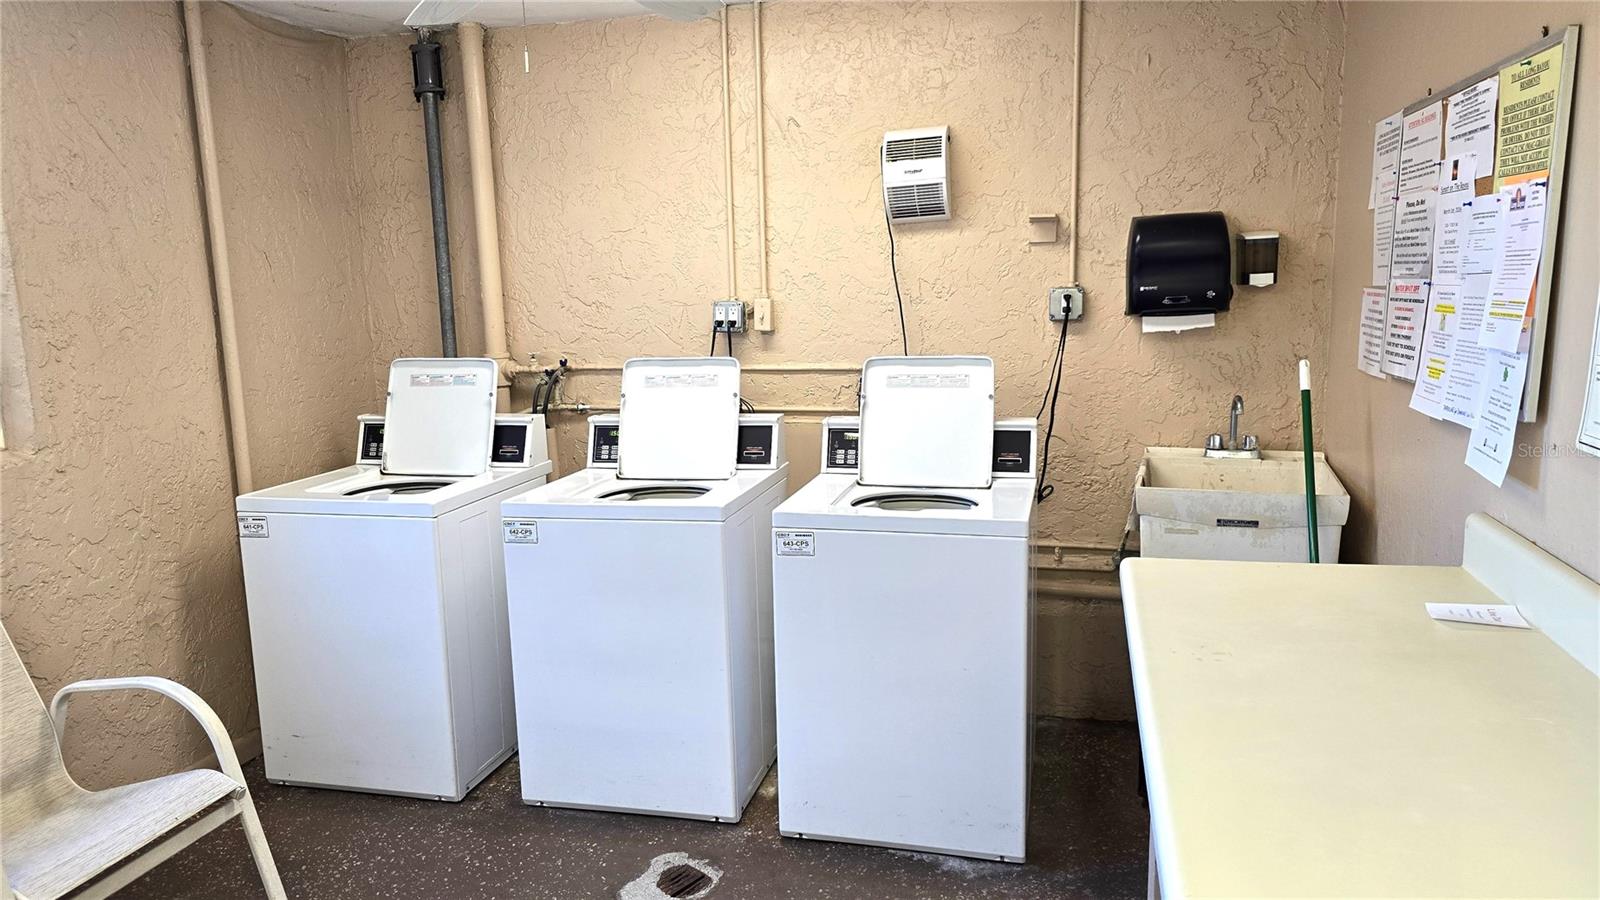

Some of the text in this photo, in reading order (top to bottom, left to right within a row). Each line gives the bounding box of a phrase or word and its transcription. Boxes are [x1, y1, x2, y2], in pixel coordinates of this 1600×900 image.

[1520, 75, 1540, 90] RESIDENTS
[1504, 102, 1523, 114] RESIDENTS
[1537, 90, 1554, 104] CONTACT
[1509, 112, 1522, 124] OFFICE
[1528, 107, 1539, 118] THERE
[1500, 124, 1520, 136] PROBLEMS
[1500, 145, 1518, 156] CONTACT
[1529, 150, 1542, 162] ACCEPT
